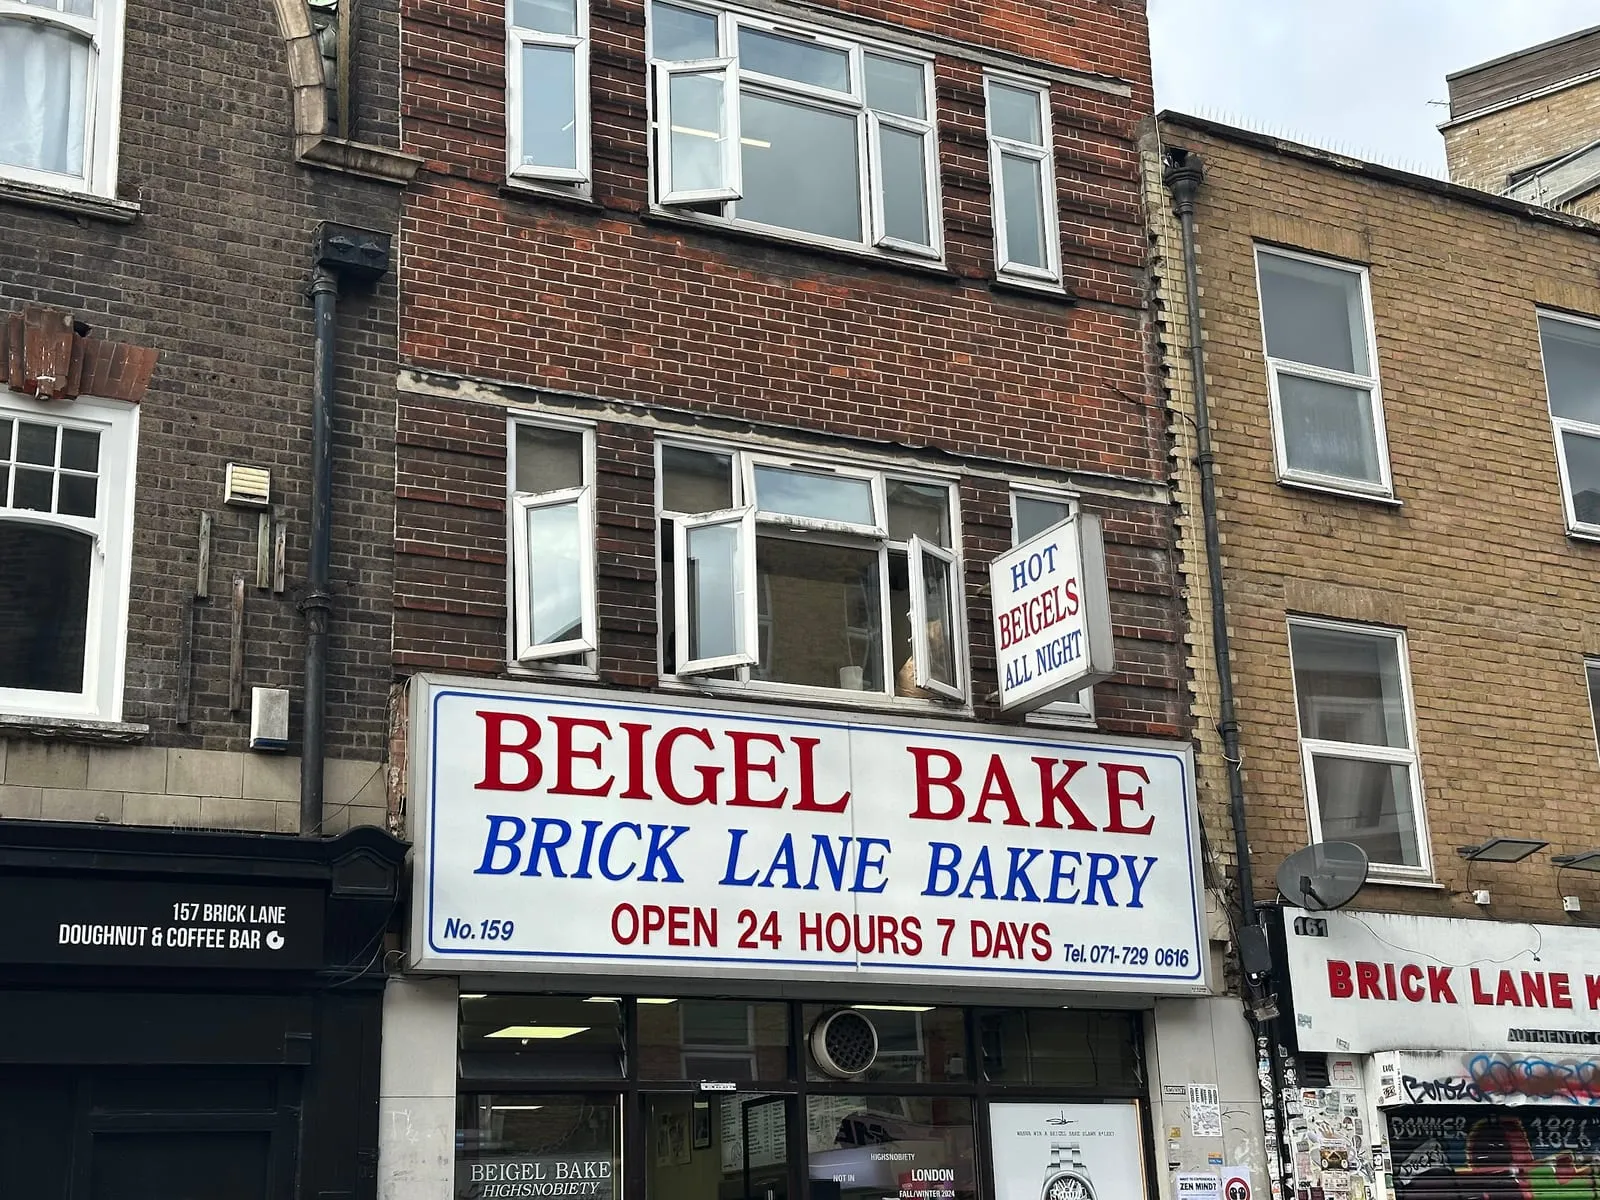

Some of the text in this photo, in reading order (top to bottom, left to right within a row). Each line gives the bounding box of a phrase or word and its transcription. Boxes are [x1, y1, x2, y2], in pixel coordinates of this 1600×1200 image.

[1010, 543, 1058, 592] HOT
[998, 577, 1079, 650] BEIGELS
[1005, 629, 1082, 691] ALL NIGHT
[474, 710, 1155, 835] BEIGEL BAKE
[473, 814, 1158, 908] BRICK LANE BAKERY
[172, 902, 286, 924] 157 BRICK LANE
[58, 924, 260, 950] DOUGHNUT & COFFEE BAR
[611, 902, 1053, 962] OPEN 24 HOURS 7 DAYS
[1294, 918, 1328, 937] 161
[1154, 947, 1189, 967] 0616
[1327, 959, 1458, 1004] BRICK
[1470, 968, 1573, 1009] LANE
[1508, 1028, 1590, 1044] AUTHENTIC
[870, 1152, 916, 1162] HIGHSNOBIETY
[470, 1161, 611, 1182] BEIGEL BAKE
[833, 1174, 855, 1182] NOT IN
[911, 1168, 954, 1182] LONDON
[482, 1181, 600, 1197] HIGHSNOBIETY
[899, 1190, 956, 1198] FALL/WINTER 2024
[1180, 1183, 1217, 1191] ZEN MIND?
